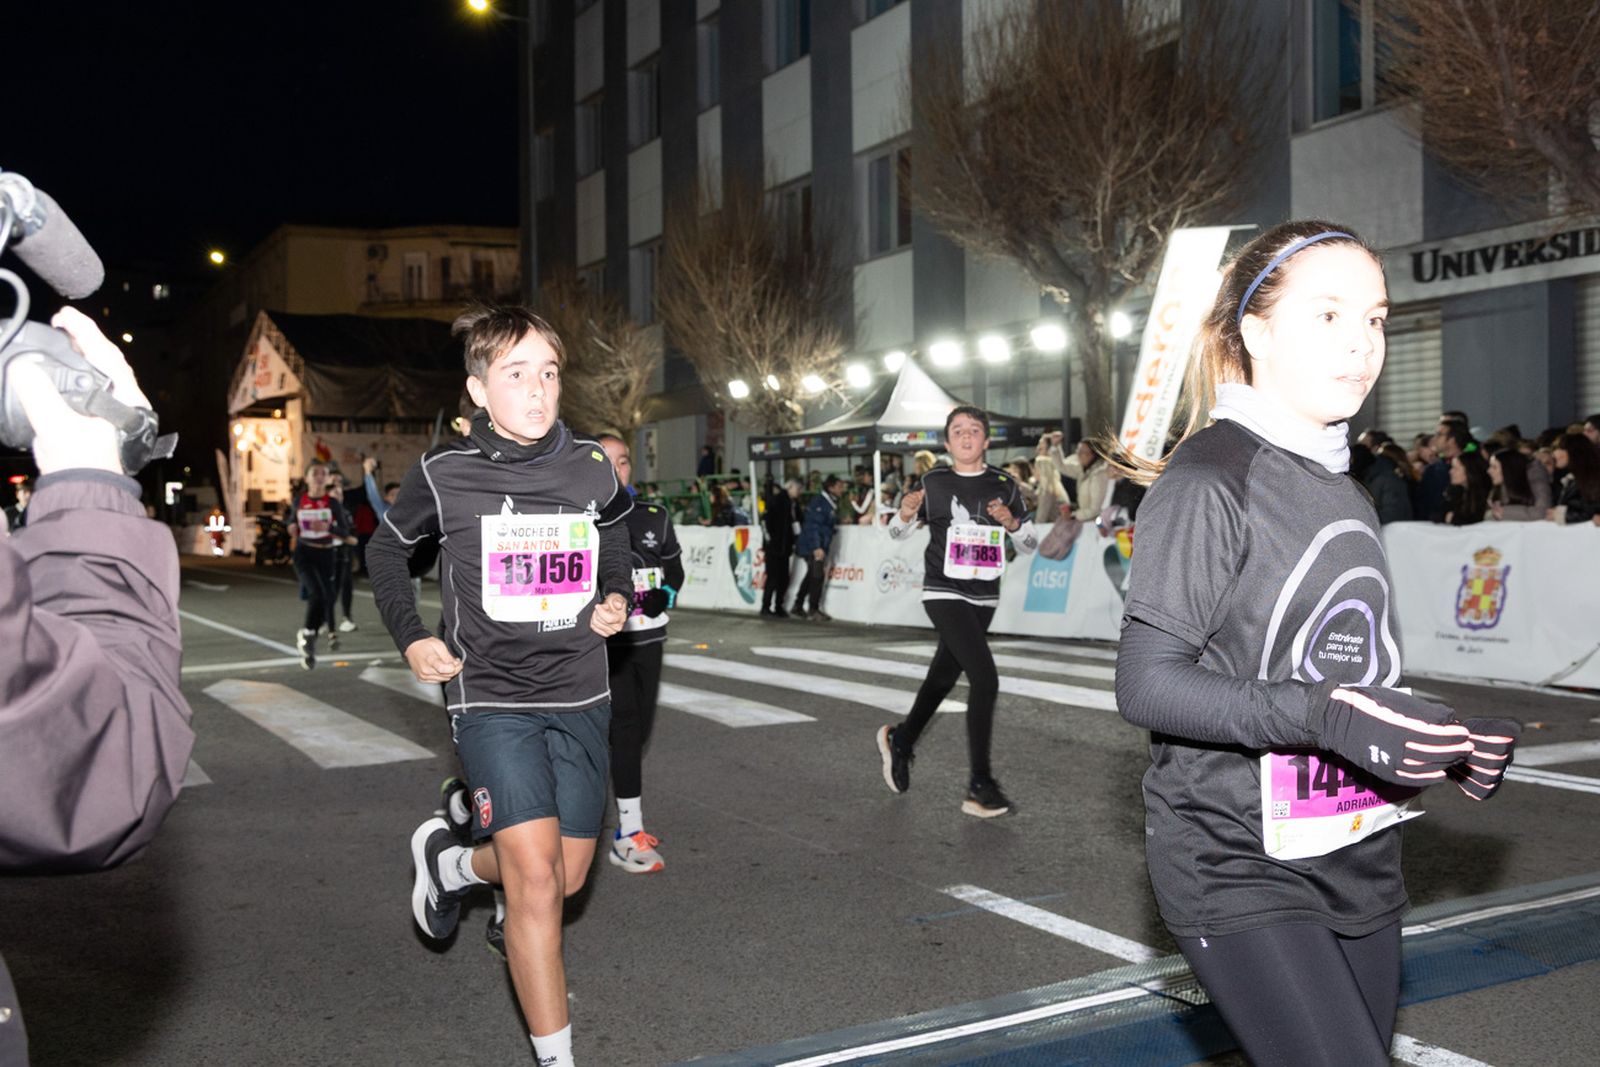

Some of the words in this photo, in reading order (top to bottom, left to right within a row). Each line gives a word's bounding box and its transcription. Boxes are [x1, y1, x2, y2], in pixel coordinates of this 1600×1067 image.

[511, 527, 545, 538] NOCHE
[547, 526, 560, 538] DE
[497, 541, 521, 552] SAN
[954, 543, 998, 562] 14583
[500, 551, 584, 586] 15156
[1032, 567, 1068, 589] alsa
[1325, 642, 1344, 652] para
[1344, 644, 1360, 653] vivir
[1318, 650, 1327, 660] tu
[1327, 651, 1351, 663] mejor
[1350, 654, 1364, 664] vida
[1336, 795, 1383, 814] ADRIANA
